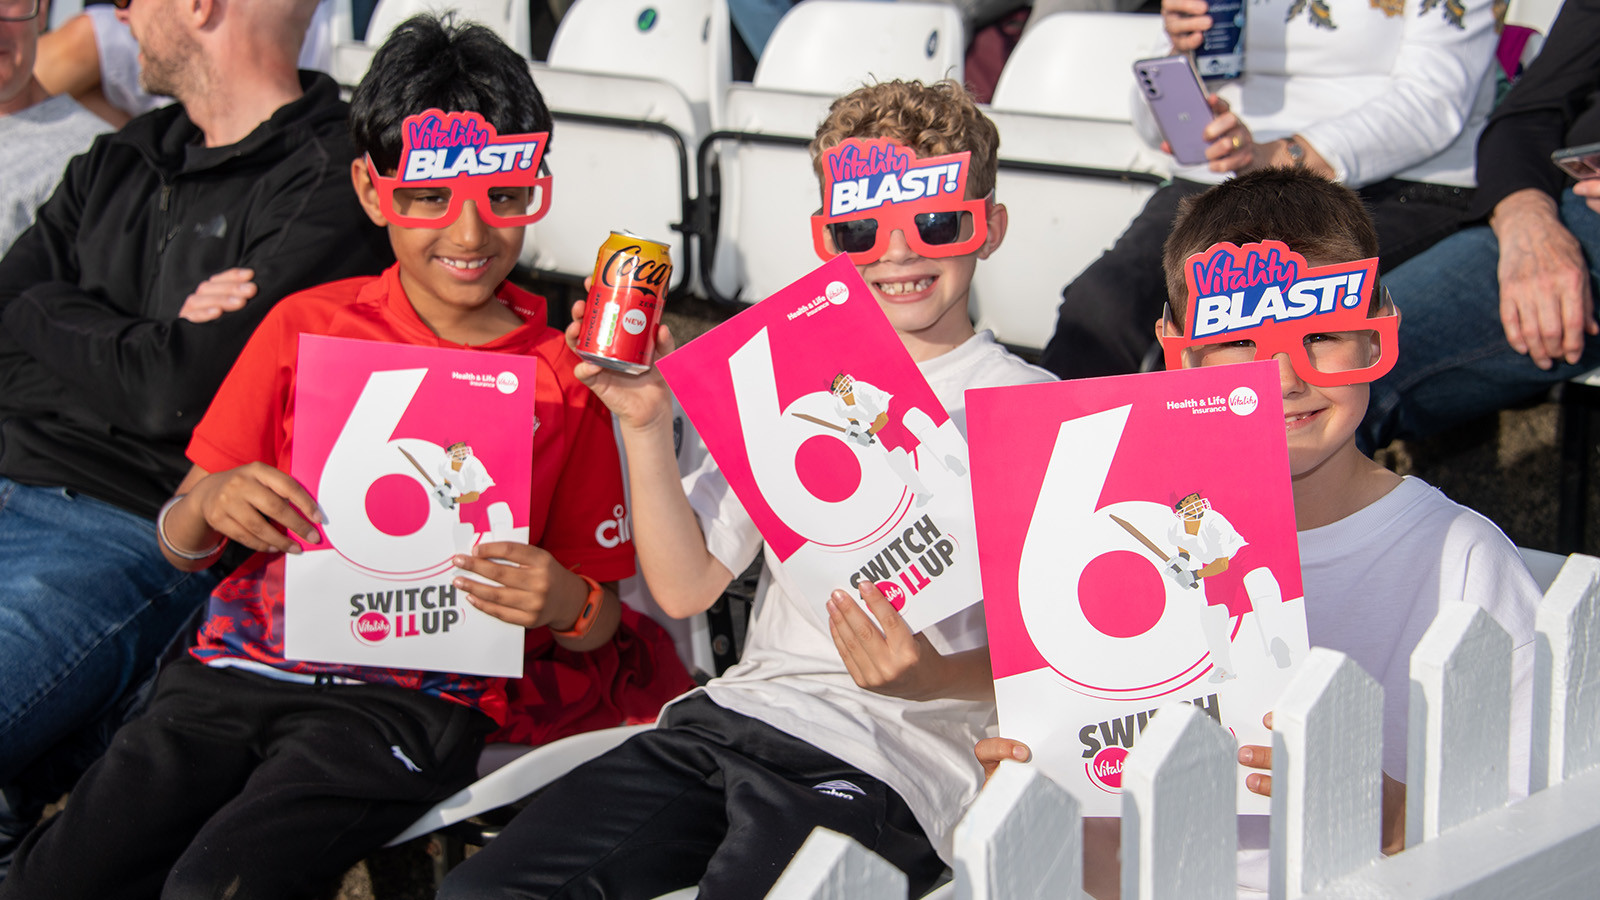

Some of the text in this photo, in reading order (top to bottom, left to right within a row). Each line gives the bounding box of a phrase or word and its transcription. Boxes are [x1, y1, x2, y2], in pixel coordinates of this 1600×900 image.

[409, 116, 488, 153] Vitality
[403, 142, 537, 181] BLAST!
[829, 145, 907, 182] Vitality
[830, 163, 960, 216] BLAST!
[601, 245, 668, 290] Coca
[1195, 250, 1297, 295] Vitality
[624, 316, 645, 327] NEW
[1193, 272, 1364, 338] BLAST!
[584, 308, 598, 348] RECYCLE
[452, 371, 476, 381] Health
[1166, 394, 1257, 410] Health & Life Vitality
[1192, 406, 1227, 414] insurance
[849, 513, 942, 600] SWITCH
[918, 539, 954, 577] UP
[350, 584, 458, 617] SWITCH
[358, 619, 390, 634] Vitality
[422, 609, 459, 634] UP
[1078, 693, 1222, 759] SWIH
